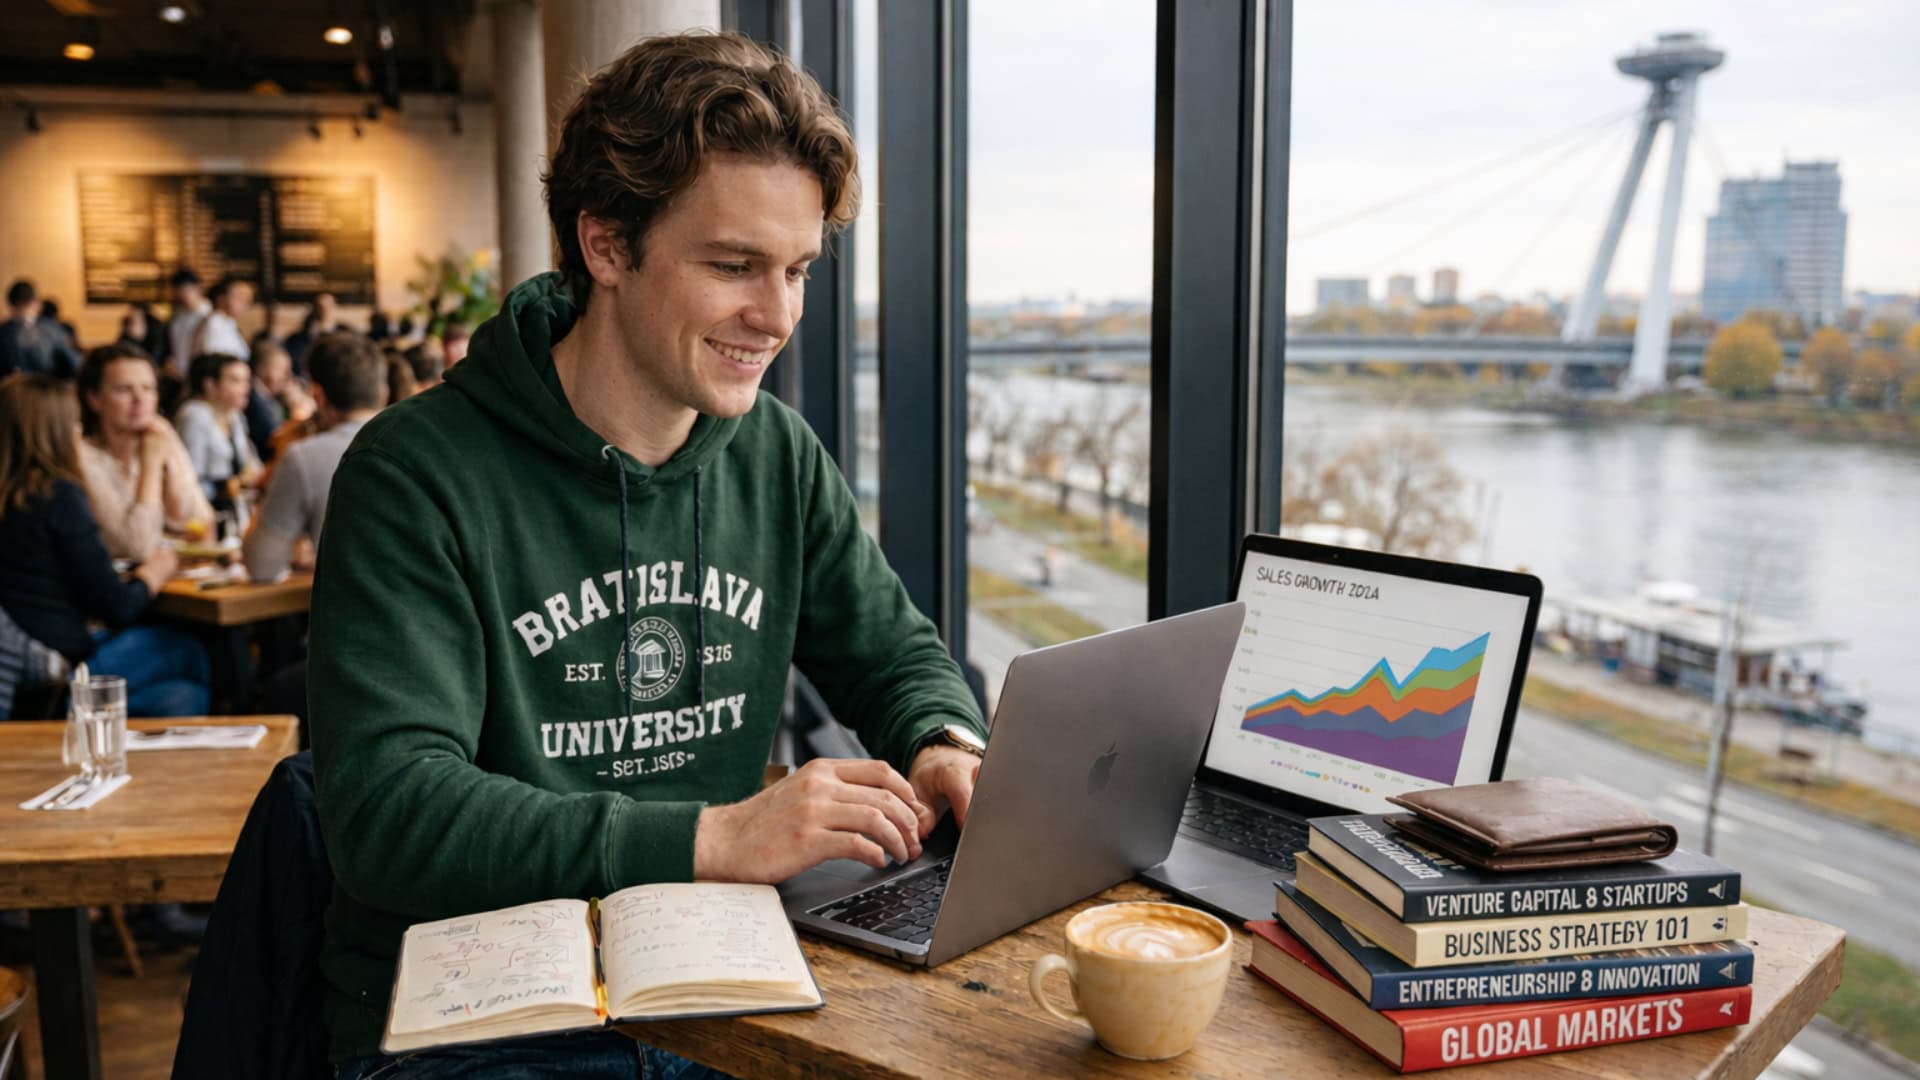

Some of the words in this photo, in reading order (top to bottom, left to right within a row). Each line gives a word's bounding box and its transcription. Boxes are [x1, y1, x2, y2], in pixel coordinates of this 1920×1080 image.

[512, 560, 764, 657] BRATISLAVA
[564, 663, 606, 682] EST.
[540, 693, 746, 758] UNIVERSITY
[1426, 891, 1505, 917] VENTURE
[1510, 887, 1582, 913] CAPITAL
[1603, 881, 1688, 907] STARTUPS
[1444, 927, 1542, 958] BUSINESS
[1549, 919, 1648, 950] STRATEGY
[1656, 915, 1689, 941] 101
[1399, 970, 1576, 1003] ENTREPRENEURSHIP
[1597, 962, 1701, 991] INNOVATION
[1441, 1016, 1548, 1063] GLOBAL
[1556, 998, 1684, 1048] MARKETS
